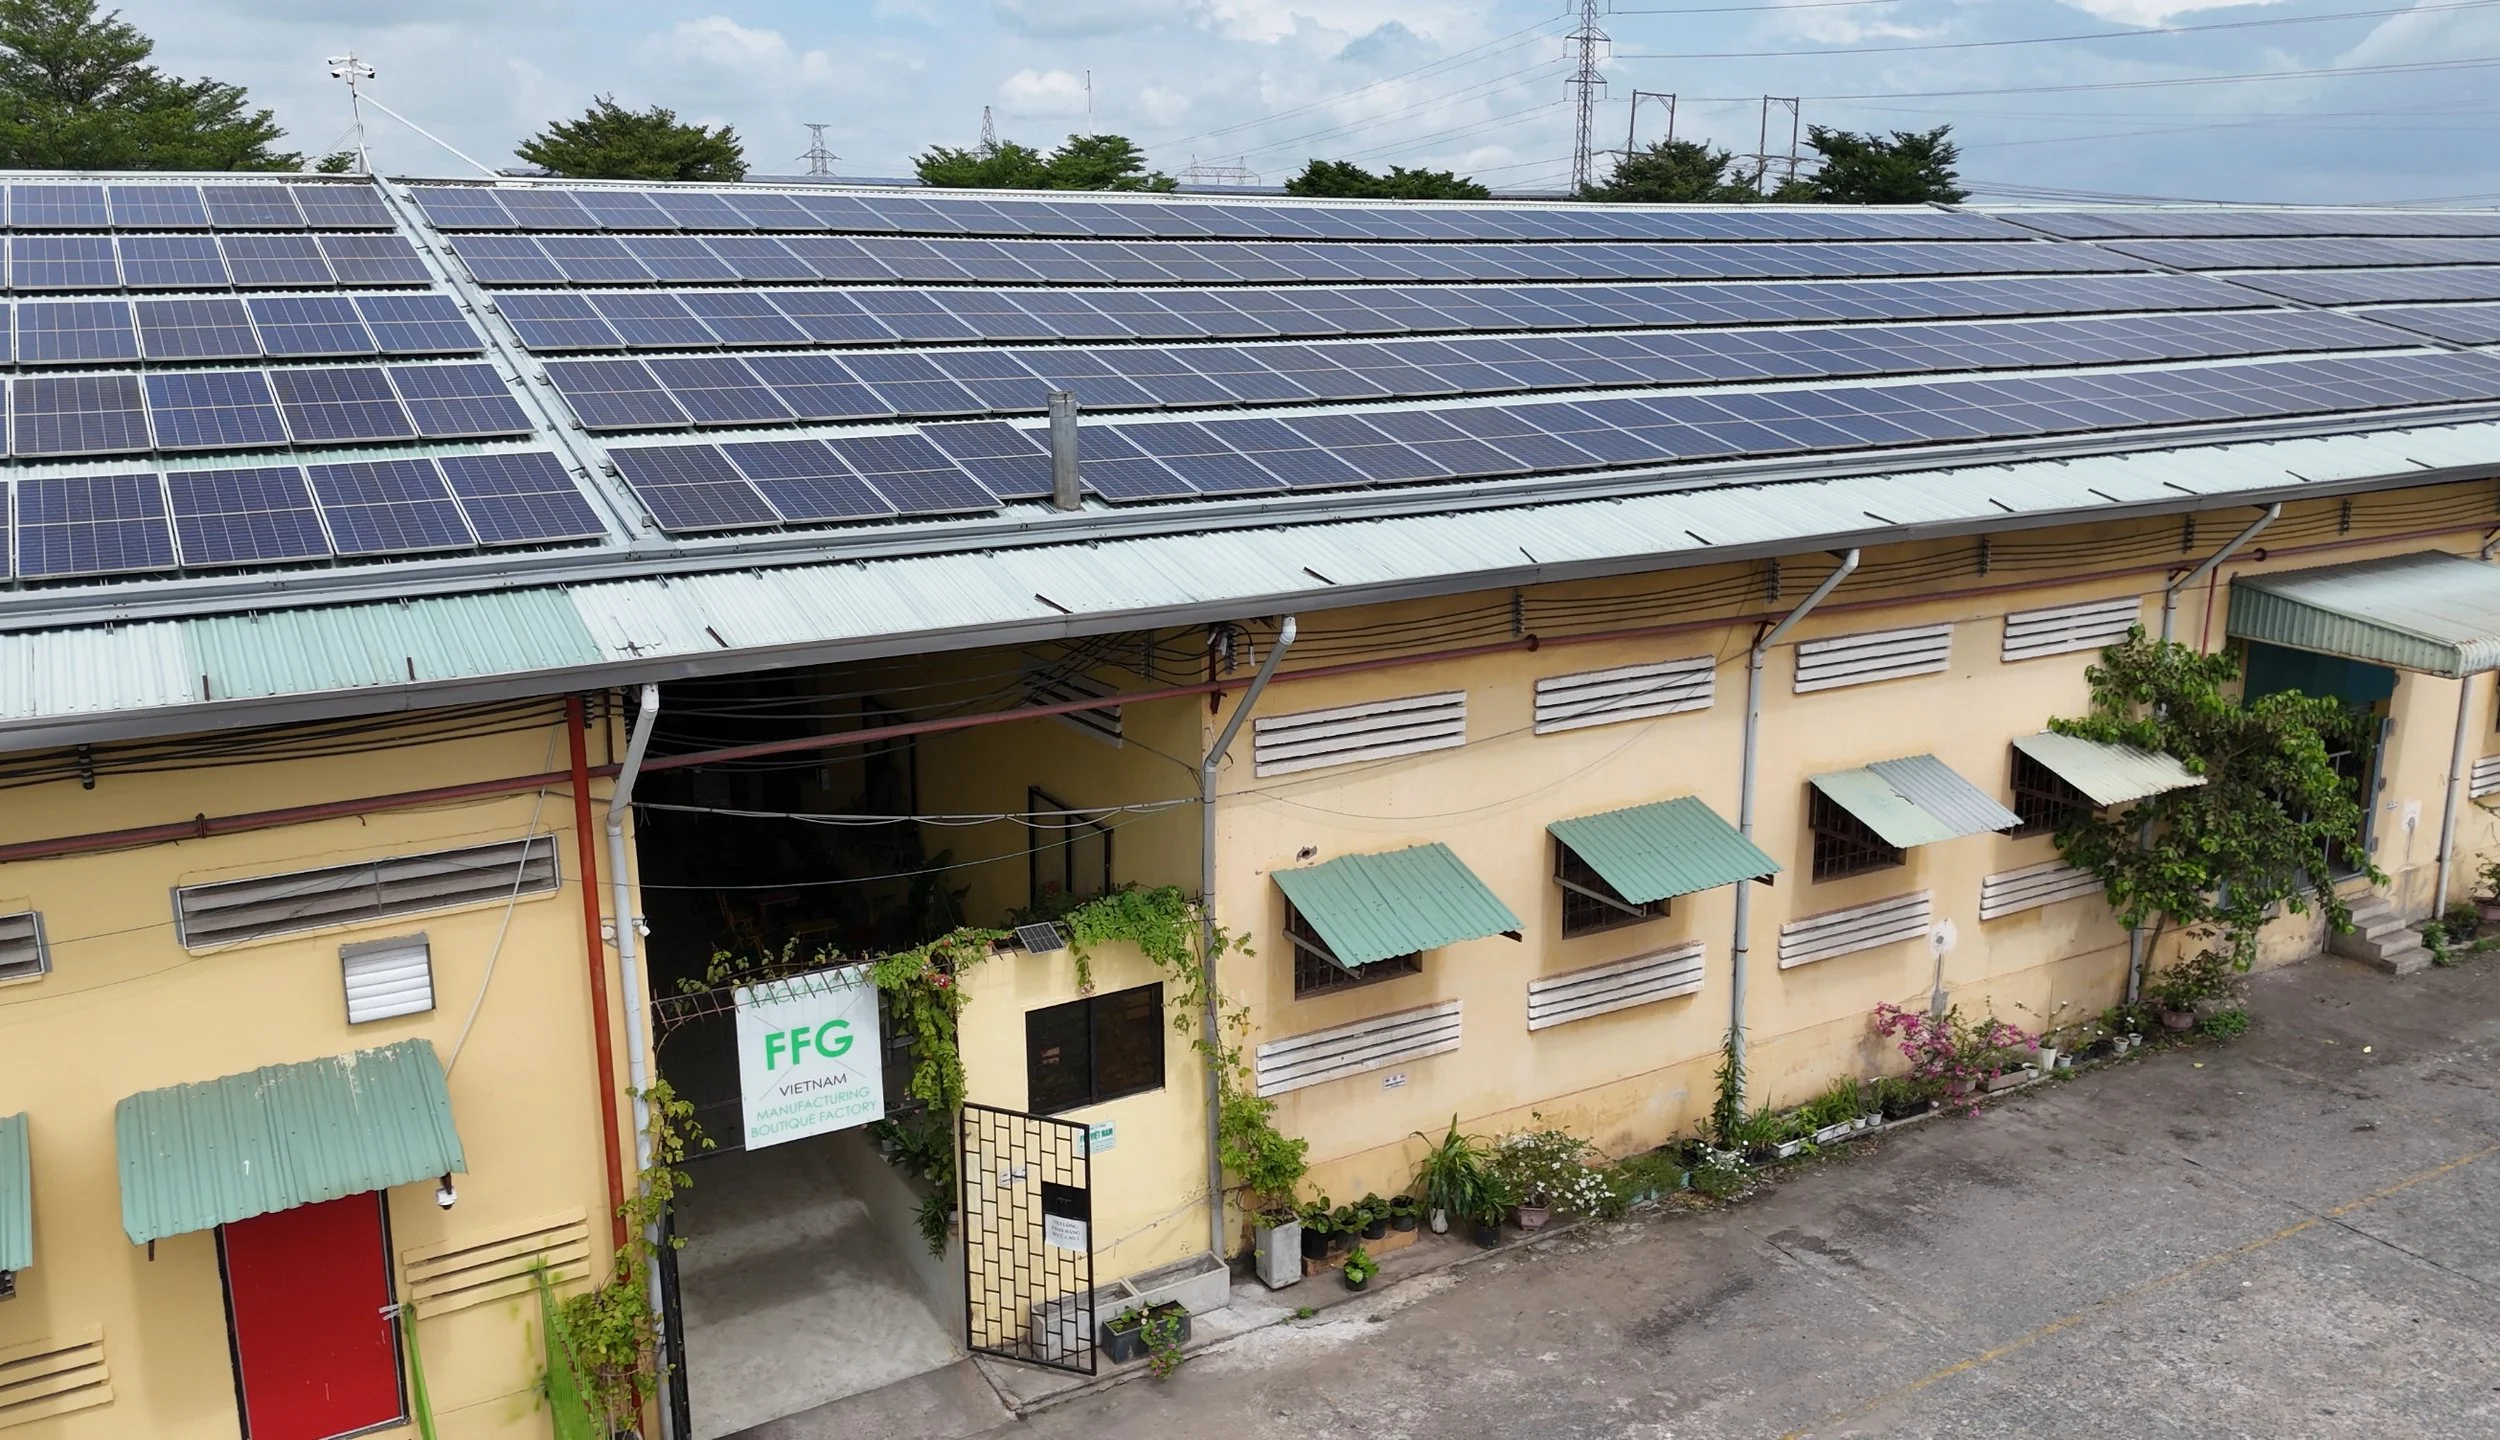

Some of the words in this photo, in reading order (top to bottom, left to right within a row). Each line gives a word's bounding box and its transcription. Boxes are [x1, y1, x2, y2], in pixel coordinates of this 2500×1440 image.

[765, 1019, 854, 1071] FFG
[756, 1086, 871, 1121] MANUFACTURING
[779, 1073, 847, 1097] VIETNAM
[751, 1112, 816, 1138] BOUTIQUE
[819, 1099, 877, 1123] FACTORY
